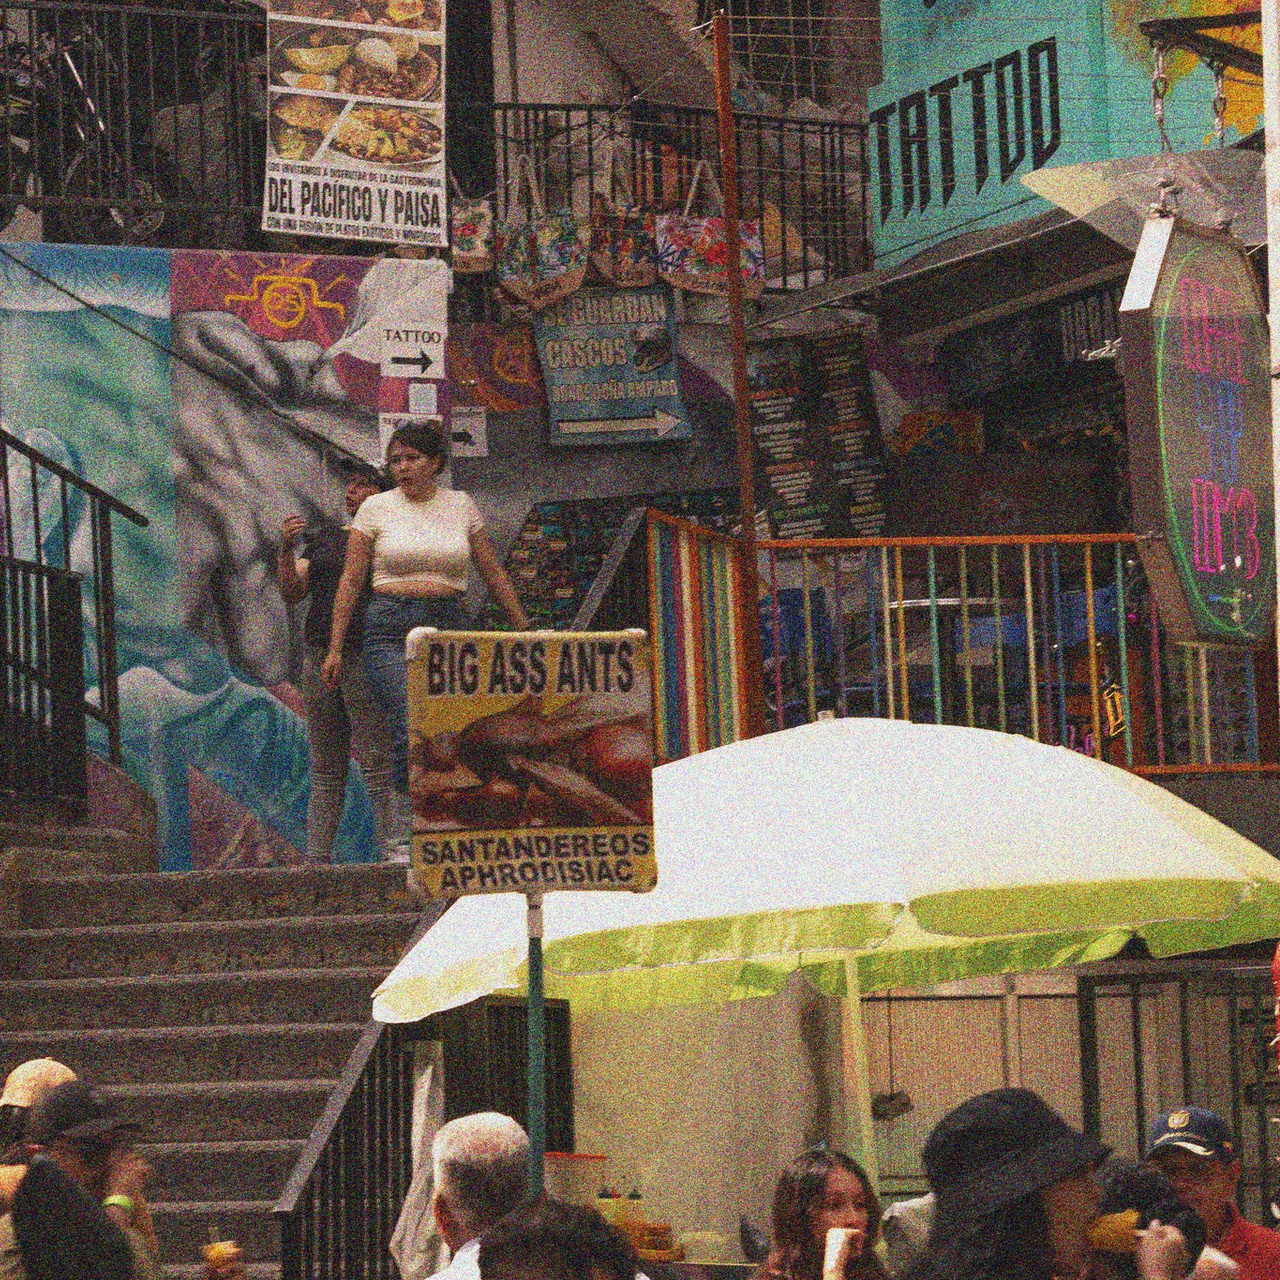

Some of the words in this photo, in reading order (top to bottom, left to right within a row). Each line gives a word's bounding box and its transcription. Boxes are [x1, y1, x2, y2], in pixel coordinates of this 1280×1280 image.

[869, 35, 1062, 228] TATTOO
[268, 177, 295, 214] DEL
[301, 179, 372, 222] PACÍFICO
[377, 188, 388, 223] Y
[394, 190, 441, 228] PAISA
[571, 293, 667, 326] GUARDAN
[383, 328, 442, 344] TATTOO
[546, 338, 628, 369] CASCOS
[426, 643, 480, 696] BIG
[489, 641, 548, 695] ASS
[556, 641, 635, 695] ANTS
